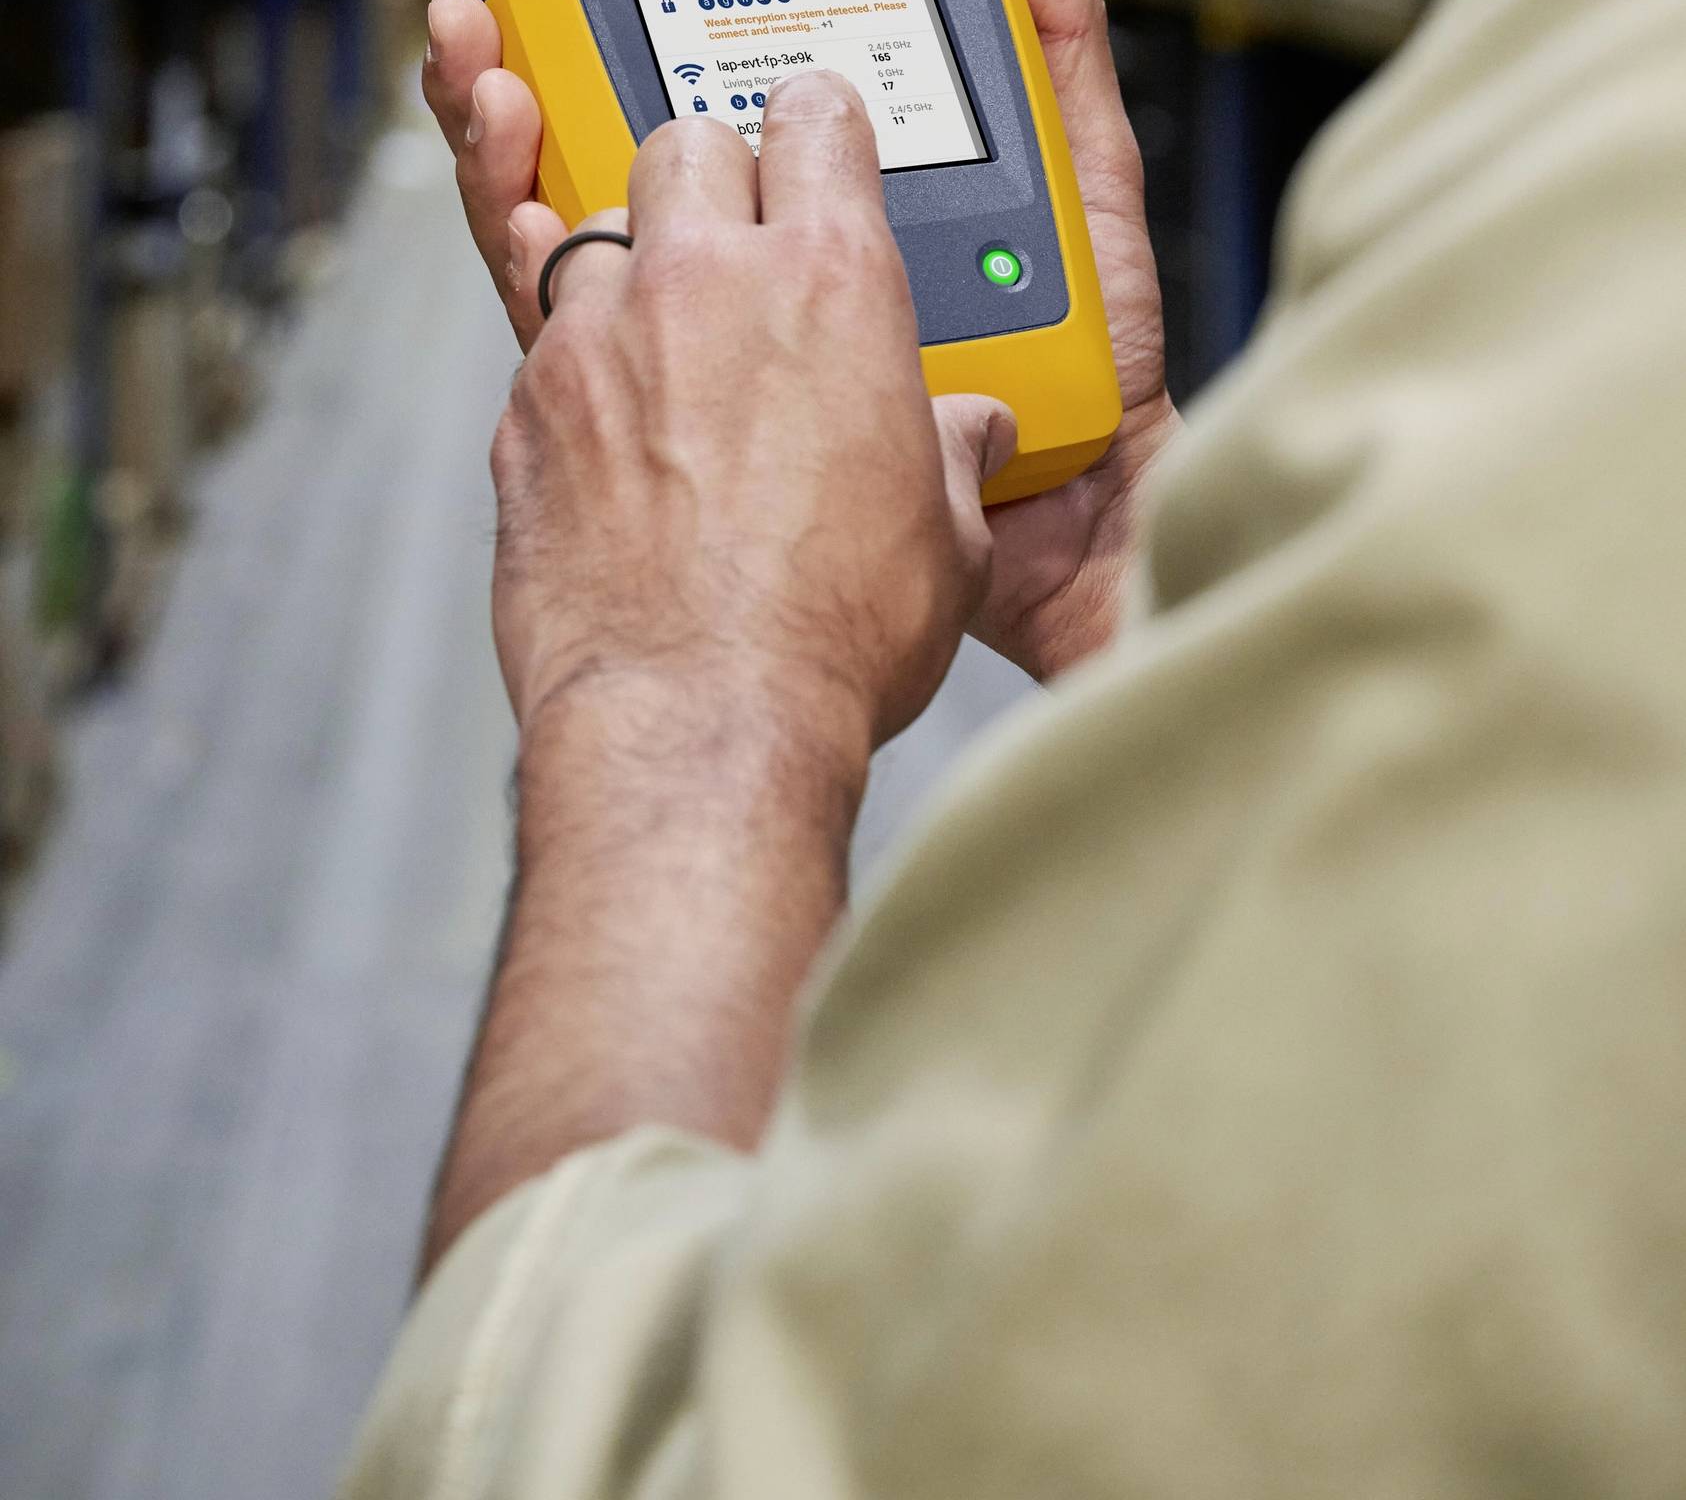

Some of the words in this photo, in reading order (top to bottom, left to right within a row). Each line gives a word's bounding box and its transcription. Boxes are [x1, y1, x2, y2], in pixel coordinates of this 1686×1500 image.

[704, 17, 733, 28] Weak
[734, 11, 788, 26] encryption
[789, 9, 825, 21] system
[826, 5, 872, 16] detected.
[873, 1, 908, 12] Please
[708, 27, 749, 40] connect
[751, 25, 769, 36] and
[771, 20, 820, 35] investig...
[820, 19, 834, 29] +1
[868, 42, 892, 52] 2.4/5
[892, 40, 912, 49] GHz
[716, 51, 815, 73] lap-evt-fp-3e9k
[871, 52, 892, 62] 165
[877, 68, 884, 78] 6
[885, 67, 905, 76] GHz
[722, 79, 754, 89] Living
[881, 81, 895, 91] 17
[889, 105, 913, 115] 2.4/5
[914, 103, 934, 111] GHz
[892, 115, 906, 125] 11
